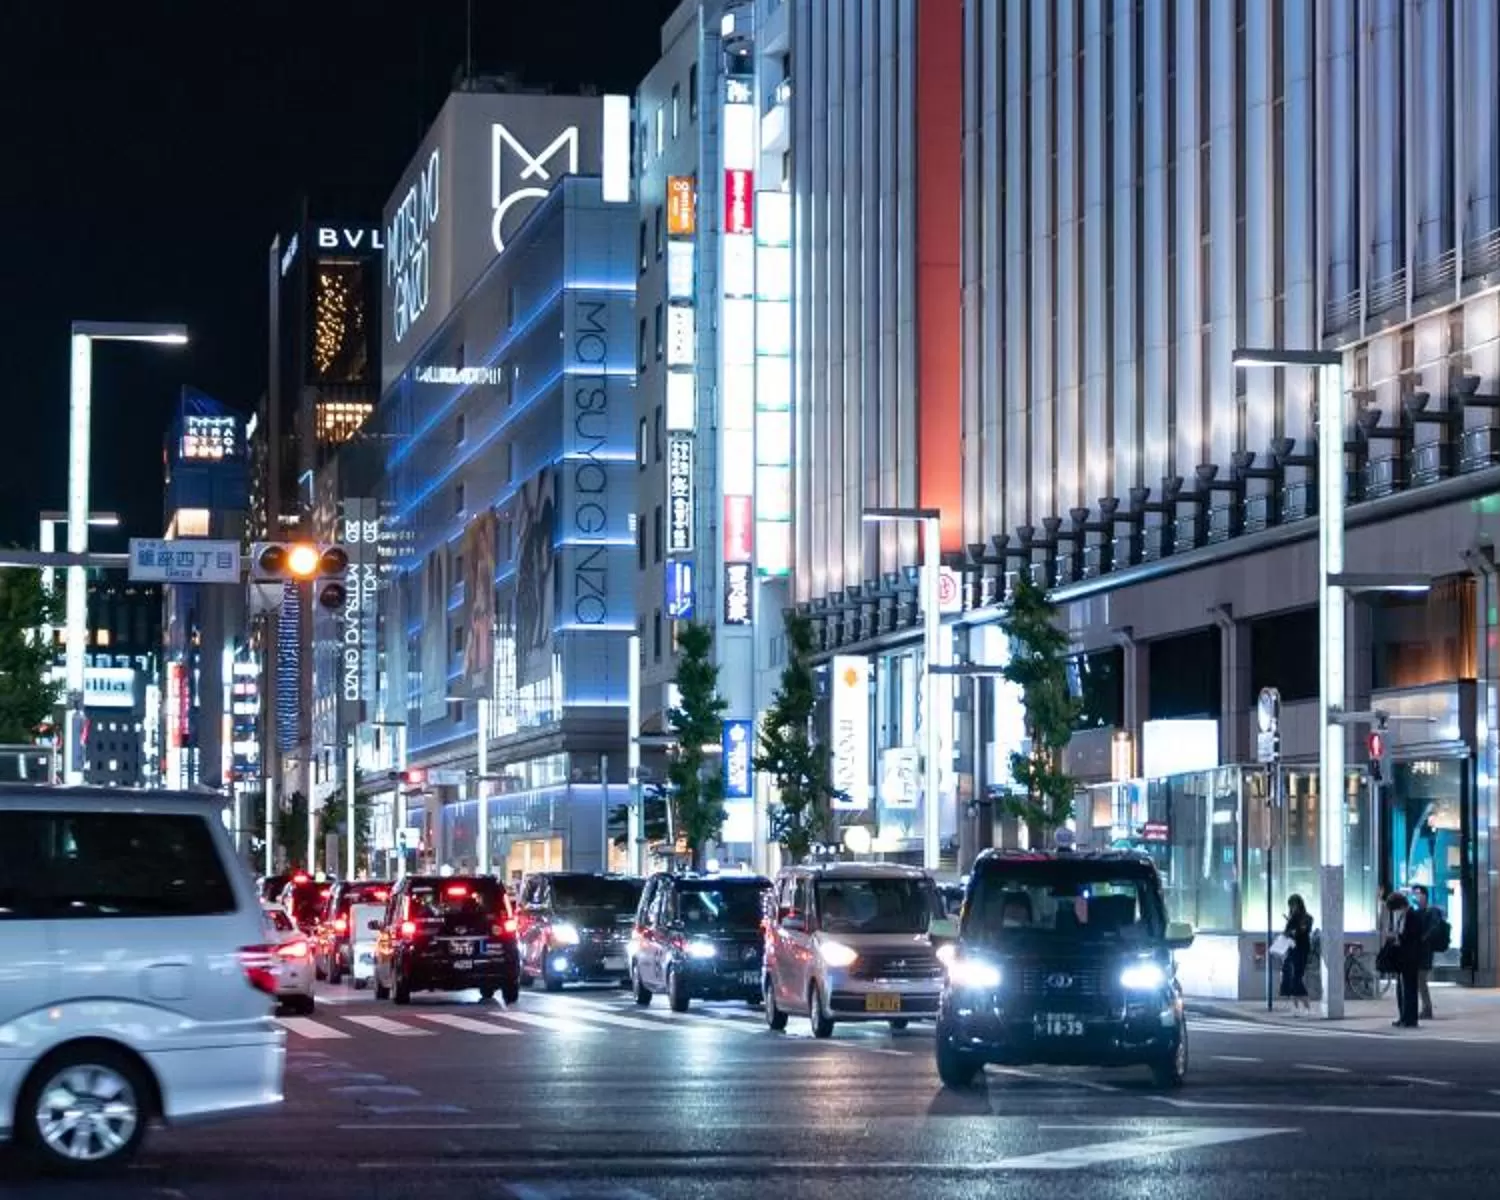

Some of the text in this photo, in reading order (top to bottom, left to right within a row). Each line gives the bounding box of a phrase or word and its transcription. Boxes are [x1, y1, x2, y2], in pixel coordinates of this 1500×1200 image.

[575, 301, 608, 626] MATSUYA GINZA
[137, 549, 234, 569] 銀座四丁目
